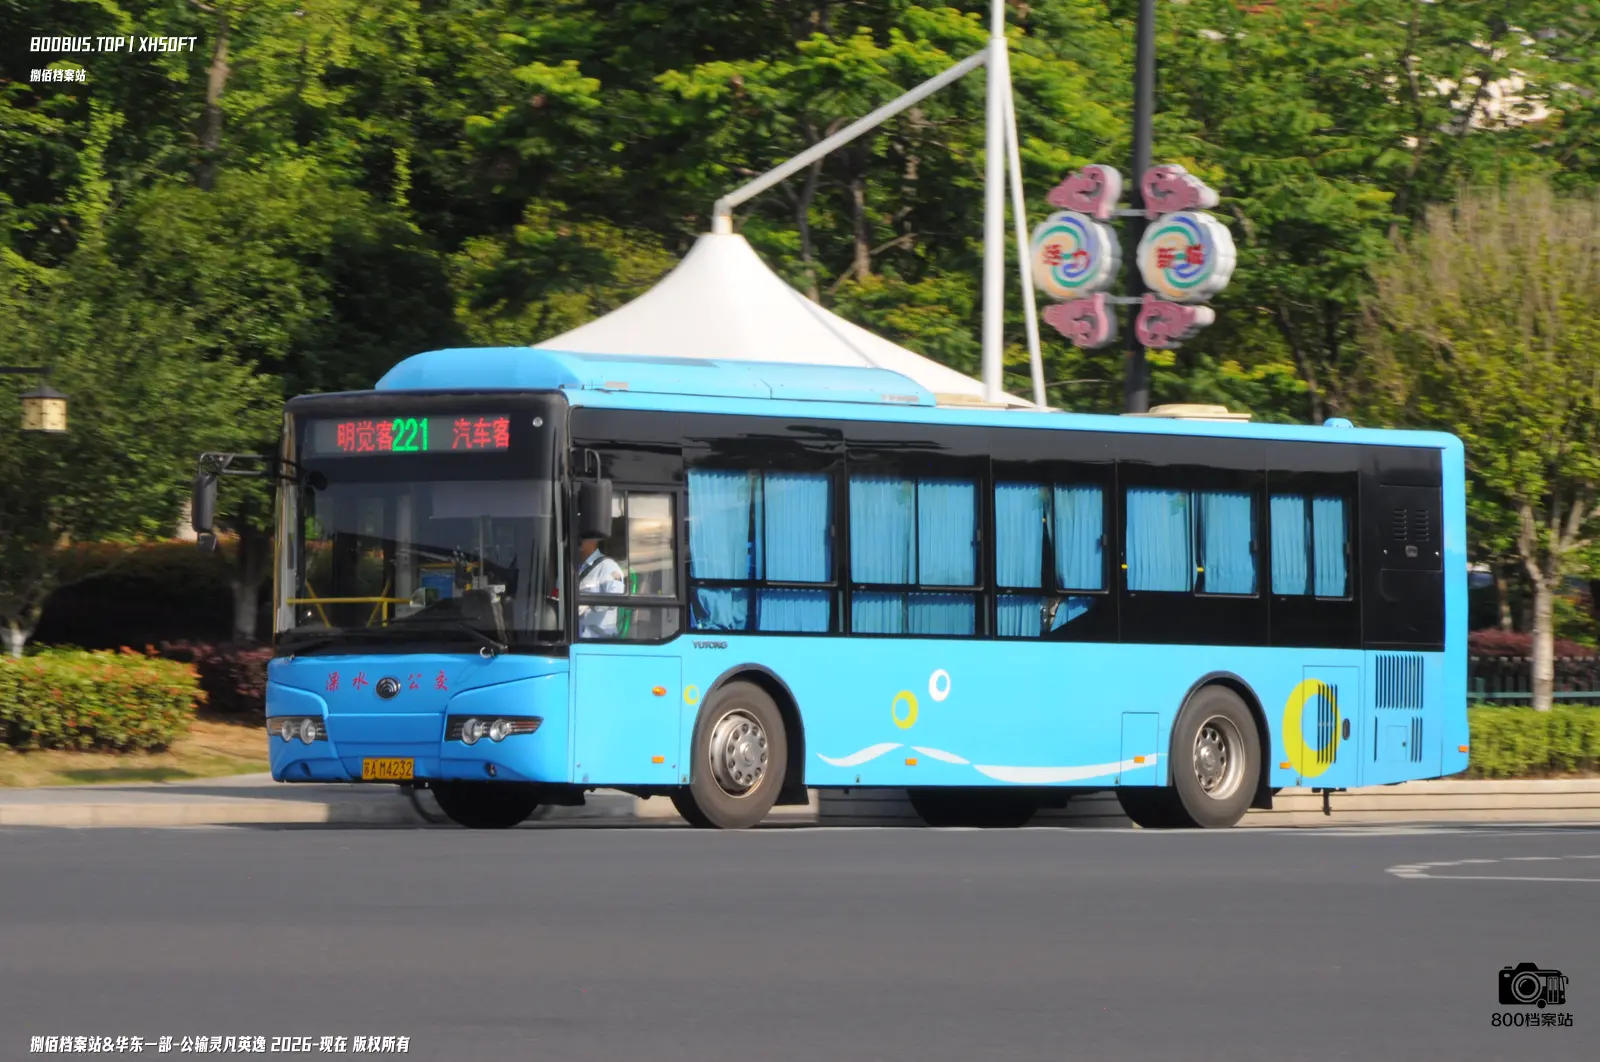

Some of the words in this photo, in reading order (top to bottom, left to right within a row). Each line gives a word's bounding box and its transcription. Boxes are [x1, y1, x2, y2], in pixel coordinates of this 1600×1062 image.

[336, 420, 394, 452] 明觉客
[391, 417, 429, 452] 221
[451, 417, 510, 449] 汽车客
[692, 640, 728, 649] YUTONG
